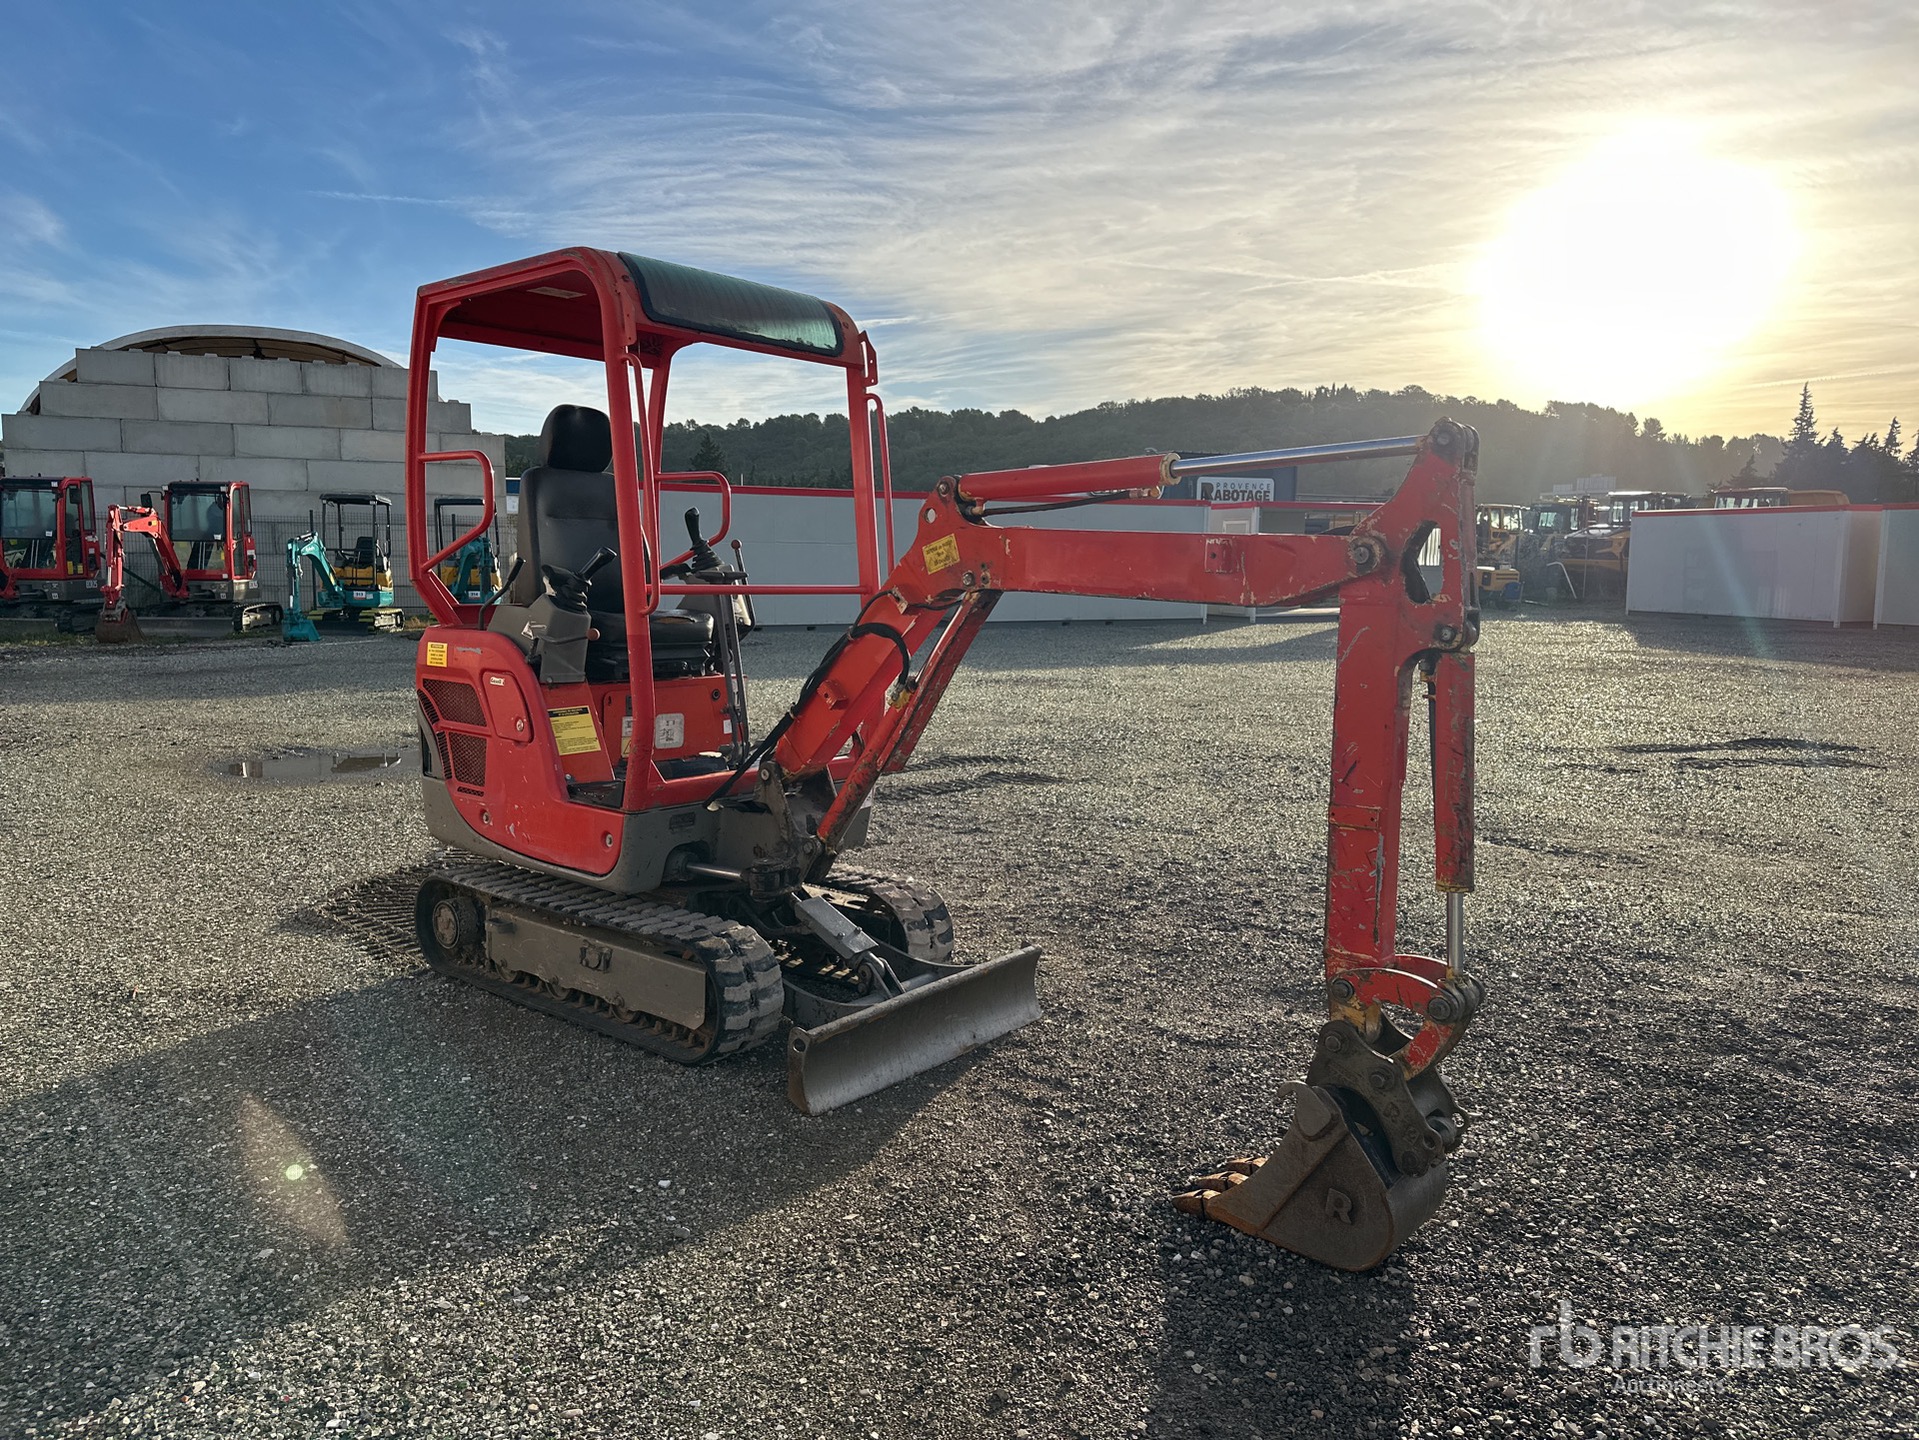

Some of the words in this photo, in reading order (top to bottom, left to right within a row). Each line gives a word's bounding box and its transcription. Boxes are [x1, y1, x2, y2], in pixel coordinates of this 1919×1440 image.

[1201, 482, 1270, 501] RABOTAGE
[1216, 482, 1271, 490] PROVENCE
[1325, 1188, 1352, 1225] R
